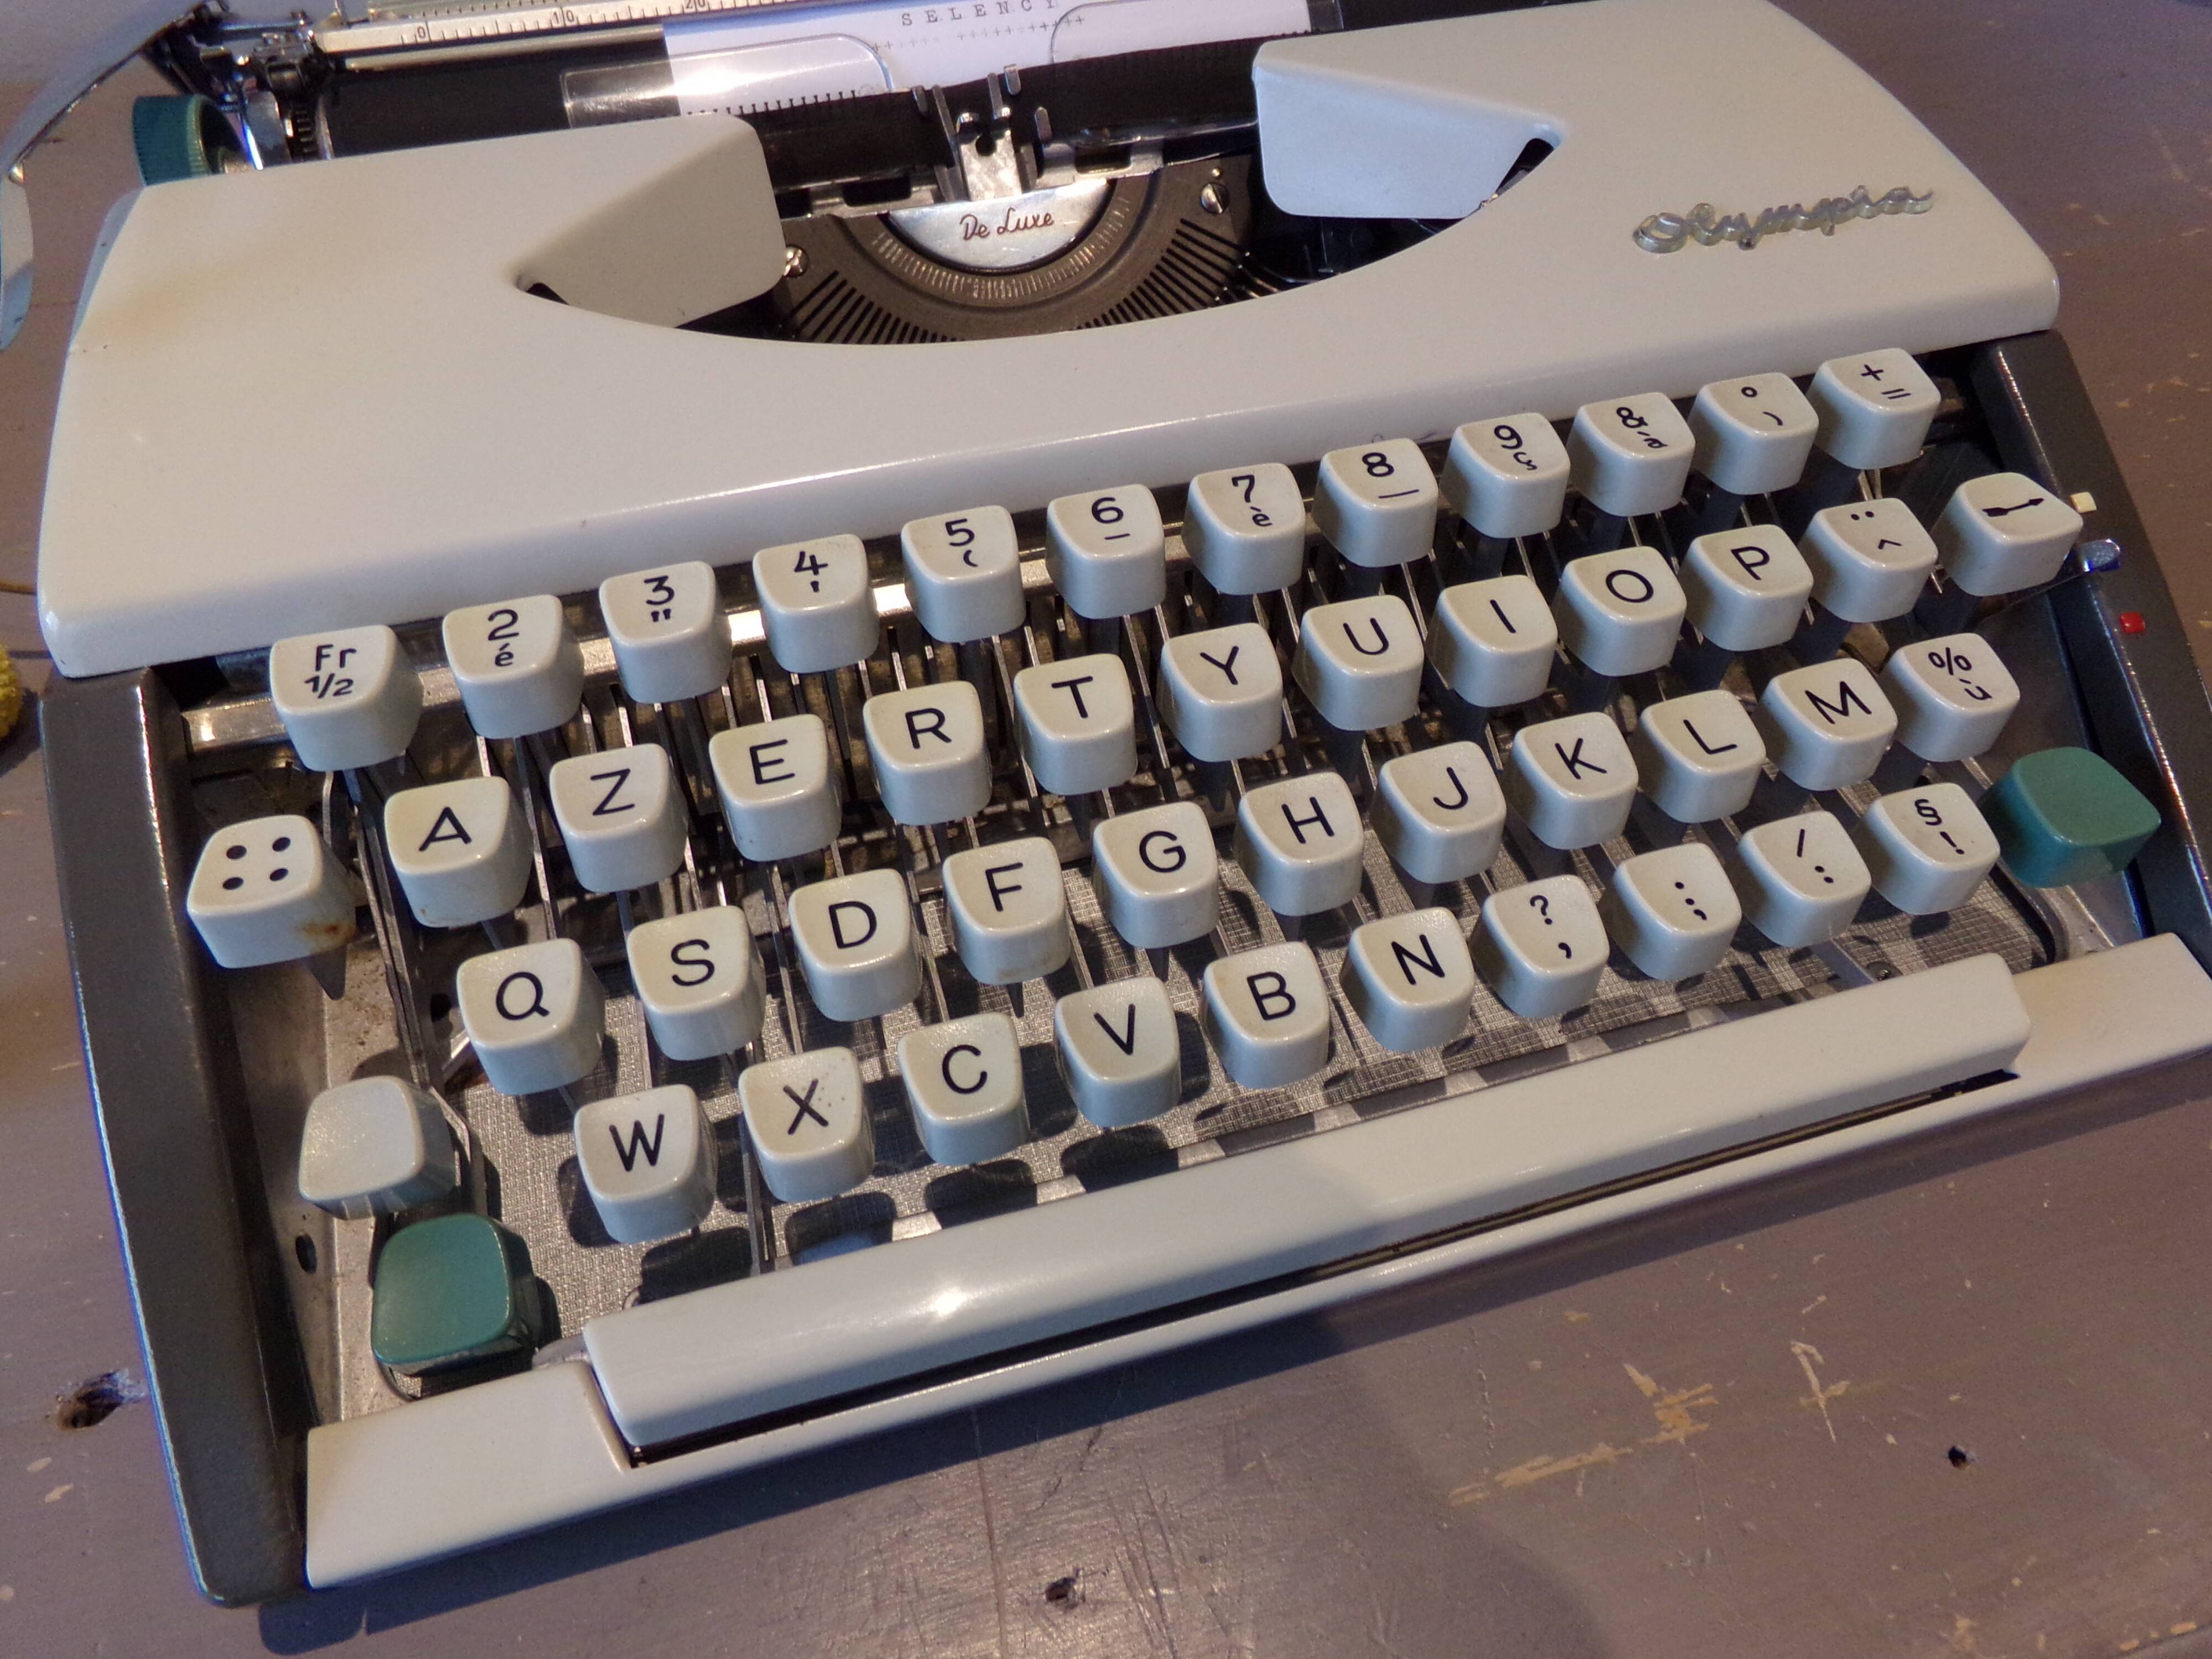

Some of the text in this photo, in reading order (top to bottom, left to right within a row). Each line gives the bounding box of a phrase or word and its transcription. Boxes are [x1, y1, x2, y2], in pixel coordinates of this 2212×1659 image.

[417, 26, 426, 39] 0
[553, 10, 575, 25] 10
[959, 207, 1055, 240] De Luxe
[1633, 185, 1934, 254] Olympia
[1494, 425, 1523, 450] 9
[1361, 452, 1395, 477] 8
[1231, 474, 1255, 503] 7
[1091, 497, 1124, 524] 6
[1250, 506, 1272, 527] è
[945, 518, 975, 547] 5
[794, 550, 828, 576] 4
[1730, 546, 1770, 581] P
[643, 575, 675, 606] 3
[1605, 569, 1654, 603] O
[487, 609, 520, 641] 2
[1342, 618, 1389, 655] U
[1489, 599, 1516, 634] I
[315, 644, 357, 672] Fr
[494, 643, 514, 667] é
[1199, 645, 1239, 685] Y
[1928, 647, 1973, 676] %
[1051, 676, 1093, 719] T
[1804, 681, 1873, 725] M
[905, 707, 952, 750] R
[1683, 719, 1738, 755] L
[749, 739, 795, 785] E
[1554, 738, 1607, 780] K
[590, 768, 635, 816] Z
[1433, 766, 1469, 810] J
[418, 806, 472, 852] A
[1281, 796, 1335, 844] H
[1139, 830, 1187, 873] G
[984, 862, 1024, 912] F
[828, 900, 877, 950] D
[1529, 895, 1553, 925] ?
[670, 938, 715, 987] S
[1391, 934, 1446, 985] N
[495, 971, 550, 1021] Q
[1246, 971, 1296, 1021] B
[1093, 1003, 1136, 1056] V
[941, 1044, 988, 1095] C
[782, 1079, 829, 1135] X
[609, 1114, 665, 1172] W
